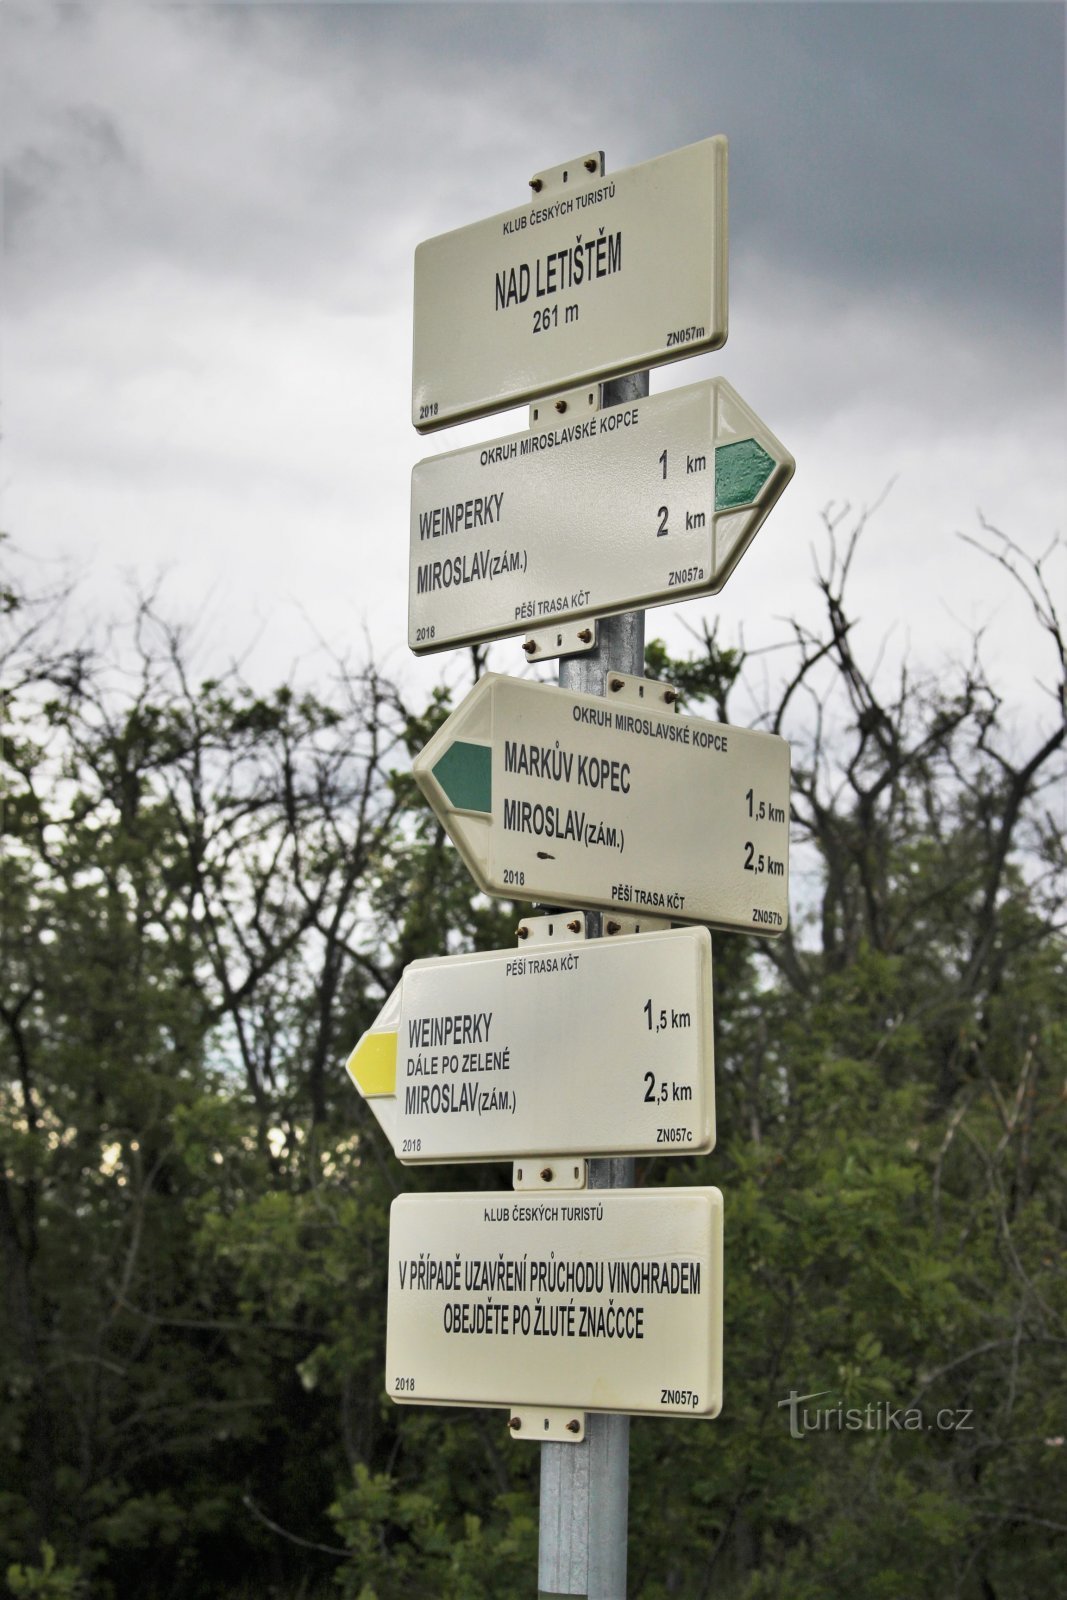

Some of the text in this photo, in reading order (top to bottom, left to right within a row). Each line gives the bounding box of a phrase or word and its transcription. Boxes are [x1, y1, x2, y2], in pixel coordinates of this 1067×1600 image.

[503, 181, 615, 236] KLUB ČESKÝCH TURISTŮ
[495, 227, 622, 311] NAD LETIŠTĚM
[533, 304, 579, 333] 261 m
[666, 326, 705, 346] ZN057m
[419, 405, 439, 419] 2018
[480, 408, 639, 466] OKRUH MIROSLAVSKÉ KOPCE
[419, 450, 706, 541] WEINPERKY 1 km
[657, 506, 668, 537] 2
[686, 511, 705, 530] km
[668, 567, 704, 586] ZN057a
[515, 590, 590, 620] PĚŠÍ TRASA KČT
[416, 627, 435, 641] 2018
[573, 706, 728, 752] OKRUH MIROSLAVSKÉ KOPCE
[504, 741, 631, 794] MARKŮV KOPEC
[745, 788, 785, 823] 1,5 km
[744, 841, 784, 876] 2,5 km
[503, 869, 525, 886] 2018
[612, 885, 685, 910] PĚŠÍ TRASA KČT
[752, 909, 782, 926] ZN057b
[506, 955, 579, 976] PĚŠÍ TRASA KČT
[408, 999, 691, 1049] WEINPERKY 1,5 km
[407, 1047, 510, 1077] DÁLE PO ZELENÉ
[644, 1071, 668, 1106] 2,5
[672, 1082, 692, 1101] km
[402, 1128, 692, 1152] 2018 ZN057c
[484, 1208, 510, 1222] KLUB
[512, 1204, 558, 1222] ČESKÝCH
[399, 1251, 701, 1294] V PŘÍPADĚ UZAVŘENÍ PRŮCHODU VINOHRADEM
[444, 1297, 644, 1339] OBEJDĚTE PO ŽLUTÉ ZNAČCCE
[395, 1378, 699, 1408] 2018 ZN057p
